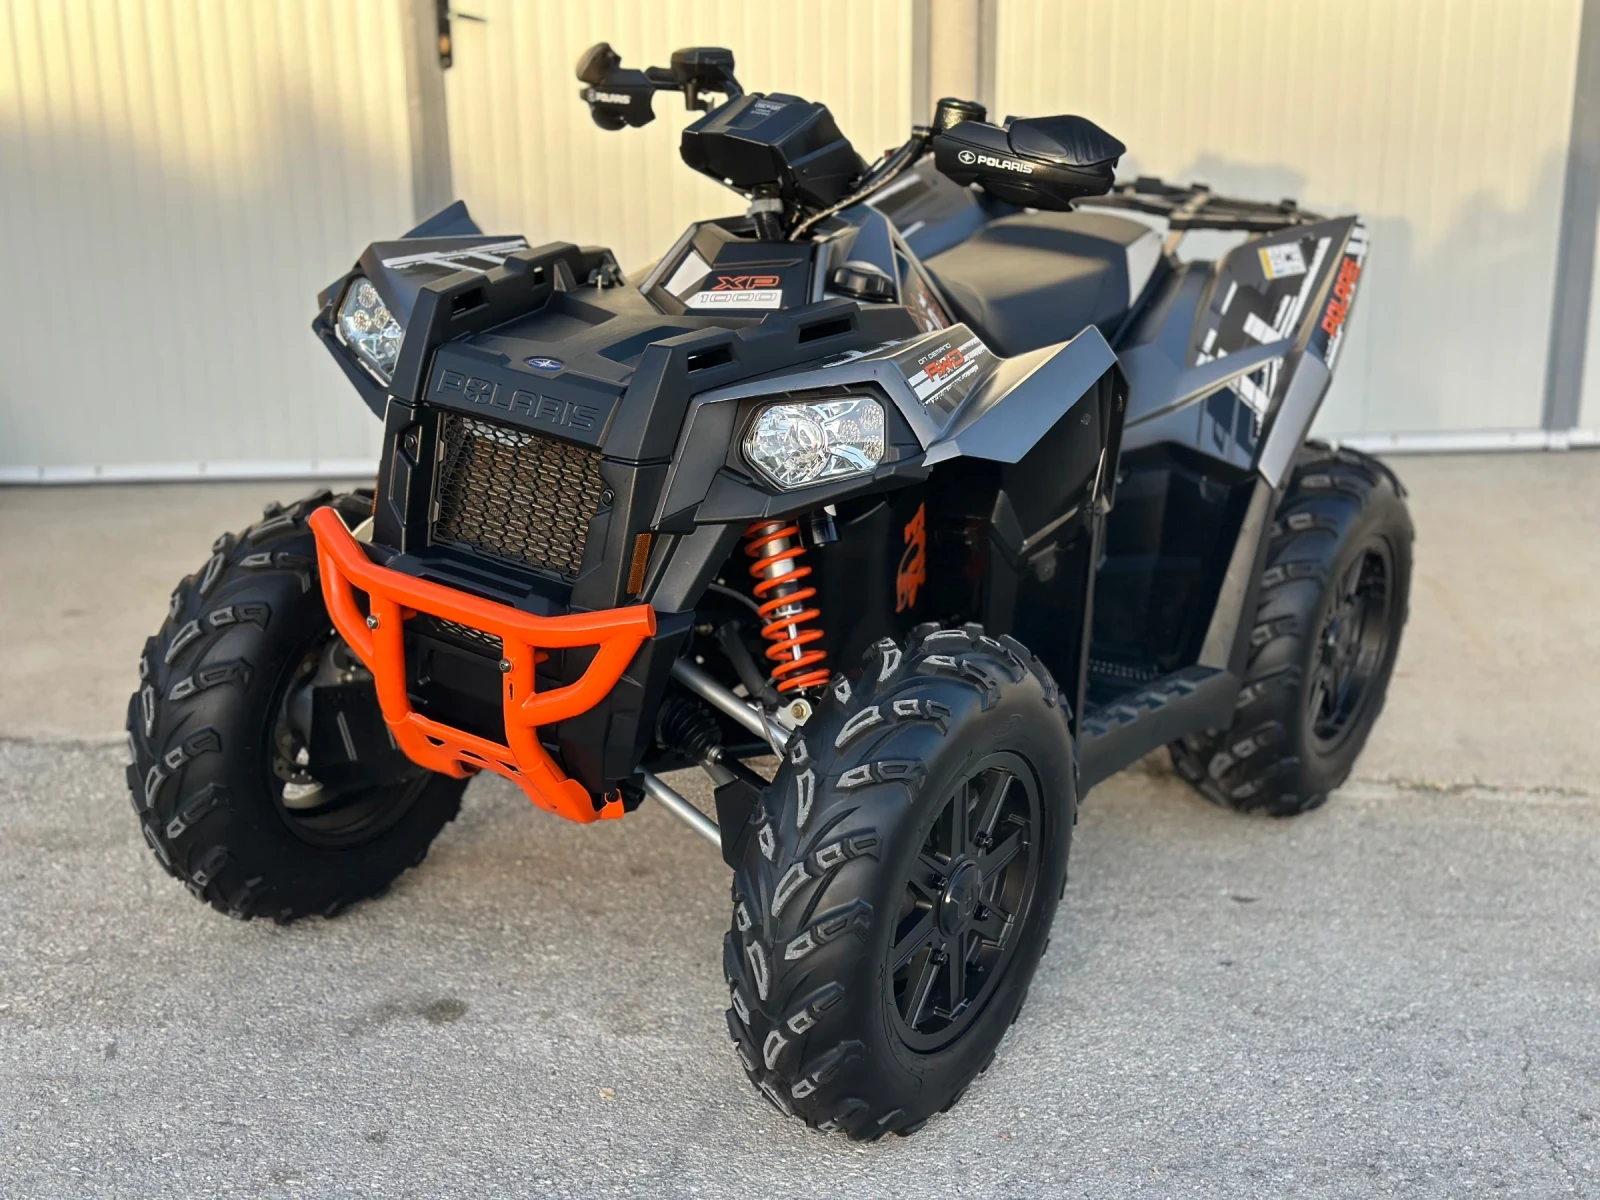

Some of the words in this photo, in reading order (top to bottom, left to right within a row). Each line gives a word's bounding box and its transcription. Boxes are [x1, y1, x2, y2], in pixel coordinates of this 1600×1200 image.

[977, 154, 1034, 174] POLARIS
[711, 275, 780, 291] XP
[700, 292, 777, 303] 1000
[1321, 256, 1361, 338] POLARIS
[918, 356, 928, 365] ON
[928, 342, 952, 362] DEMAND
[436, 368, 600, 433] POLARIS
